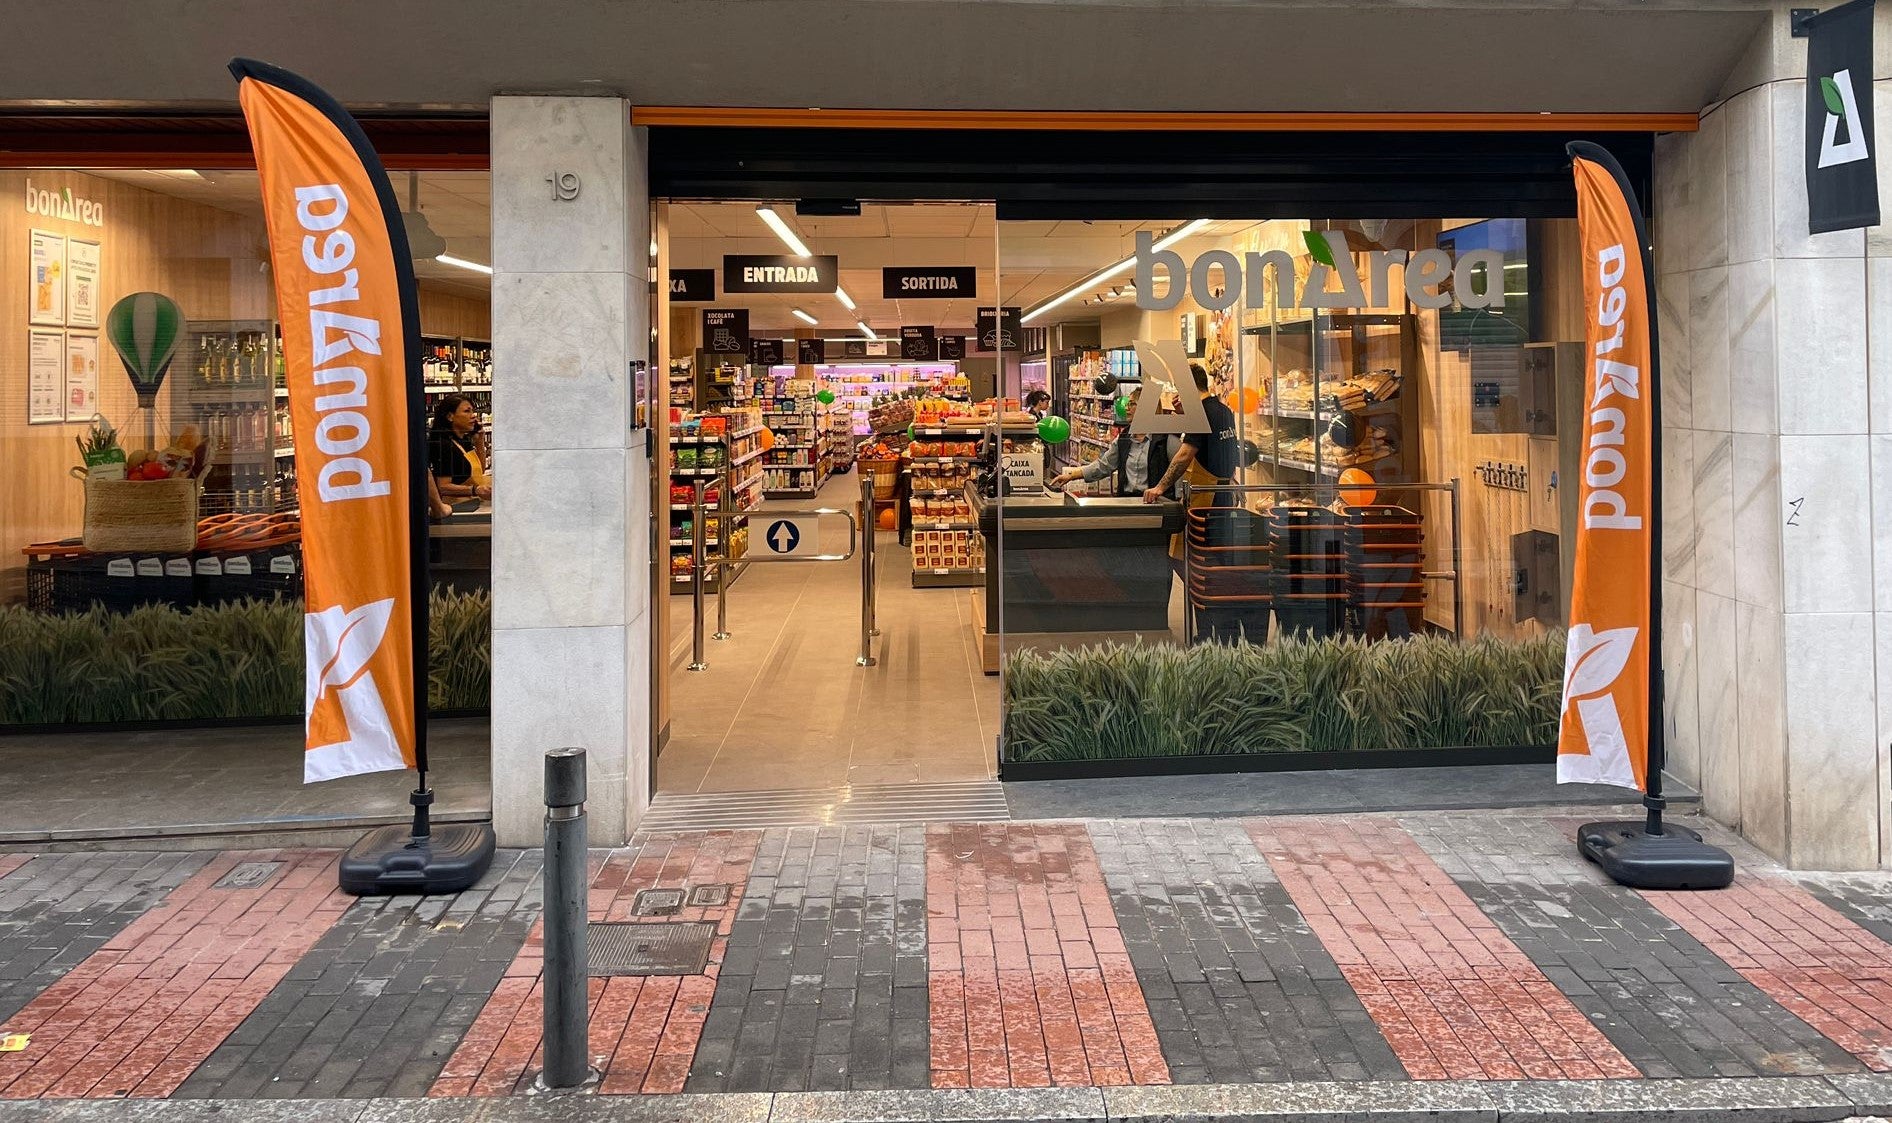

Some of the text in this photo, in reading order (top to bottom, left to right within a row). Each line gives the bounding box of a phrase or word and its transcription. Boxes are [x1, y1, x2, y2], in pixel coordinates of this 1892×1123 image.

[545, 170, 582, 202] 19
[26, 177, 104, 228] bonArea
[743, 266, 820, 284] ENTRADA
[1134, 229, 1507, 312] bonArea
[900, 276, 959, 291] SORTIDA
[1006, 469, 1035, 477] TANCADA
[1010, 460, 1030, 468] CAIXA
